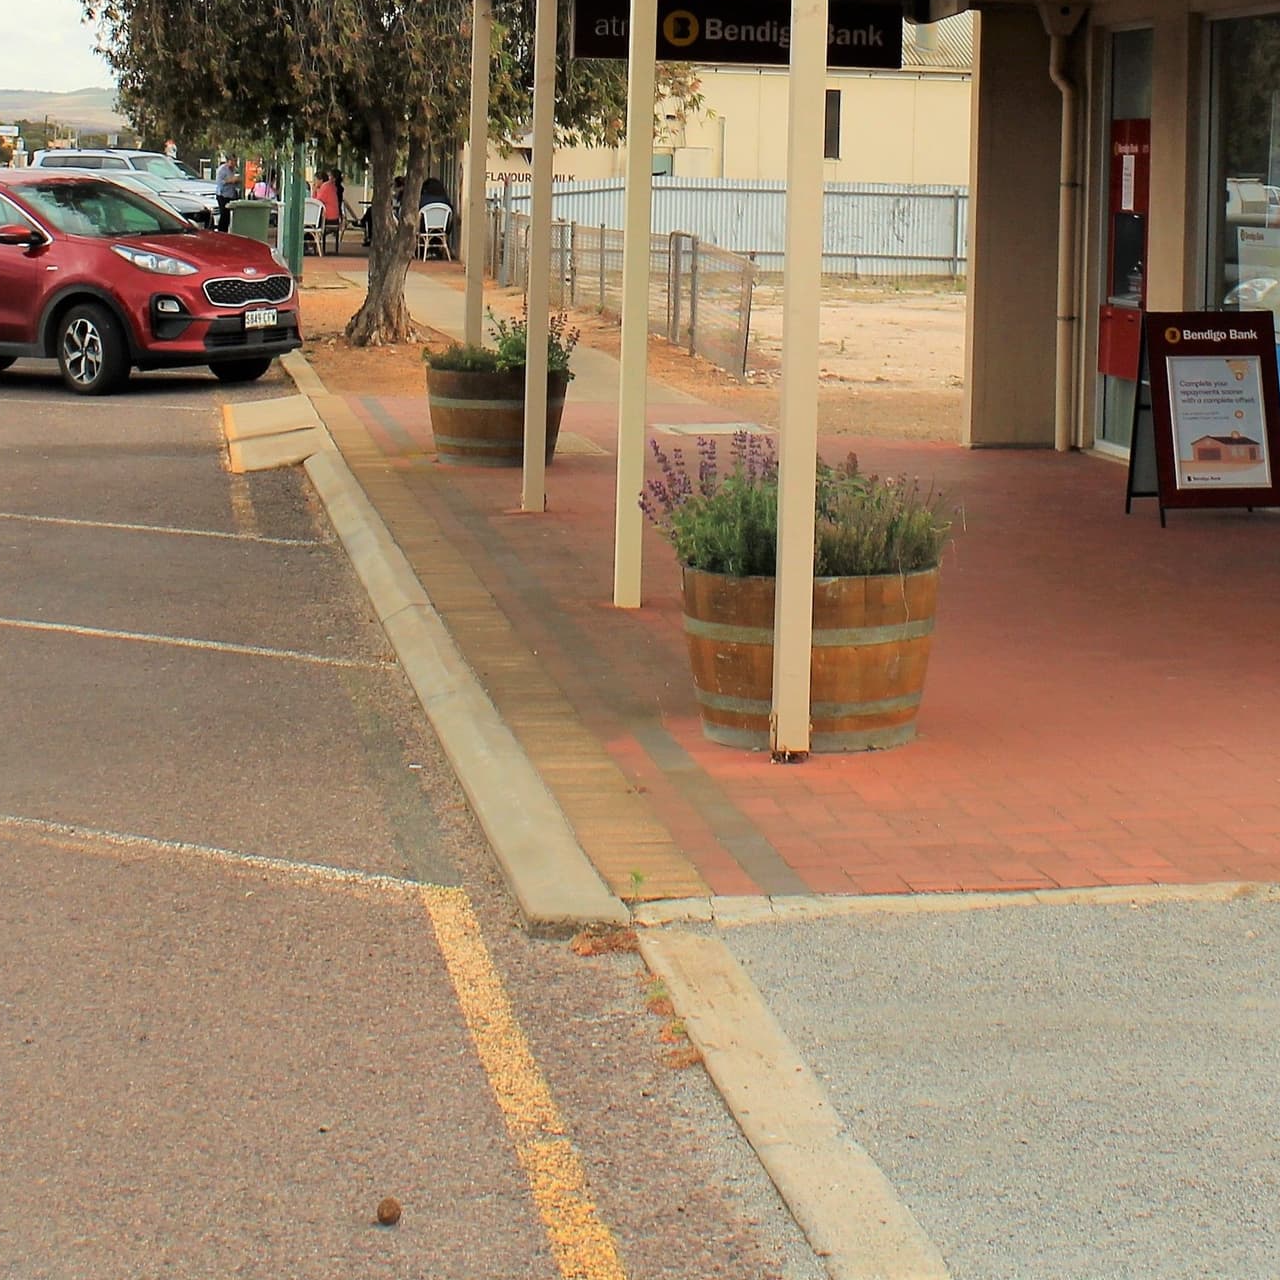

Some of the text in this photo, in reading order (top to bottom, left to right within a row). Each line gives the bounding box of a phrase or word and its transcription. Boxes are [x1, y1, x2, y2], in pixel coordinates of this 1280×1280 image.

[705, 18, 791, 48] Bendig
[485, 171, 533, 183] FLAVOUR
[1182, 329, 1258, 341] Bendigo Bank
